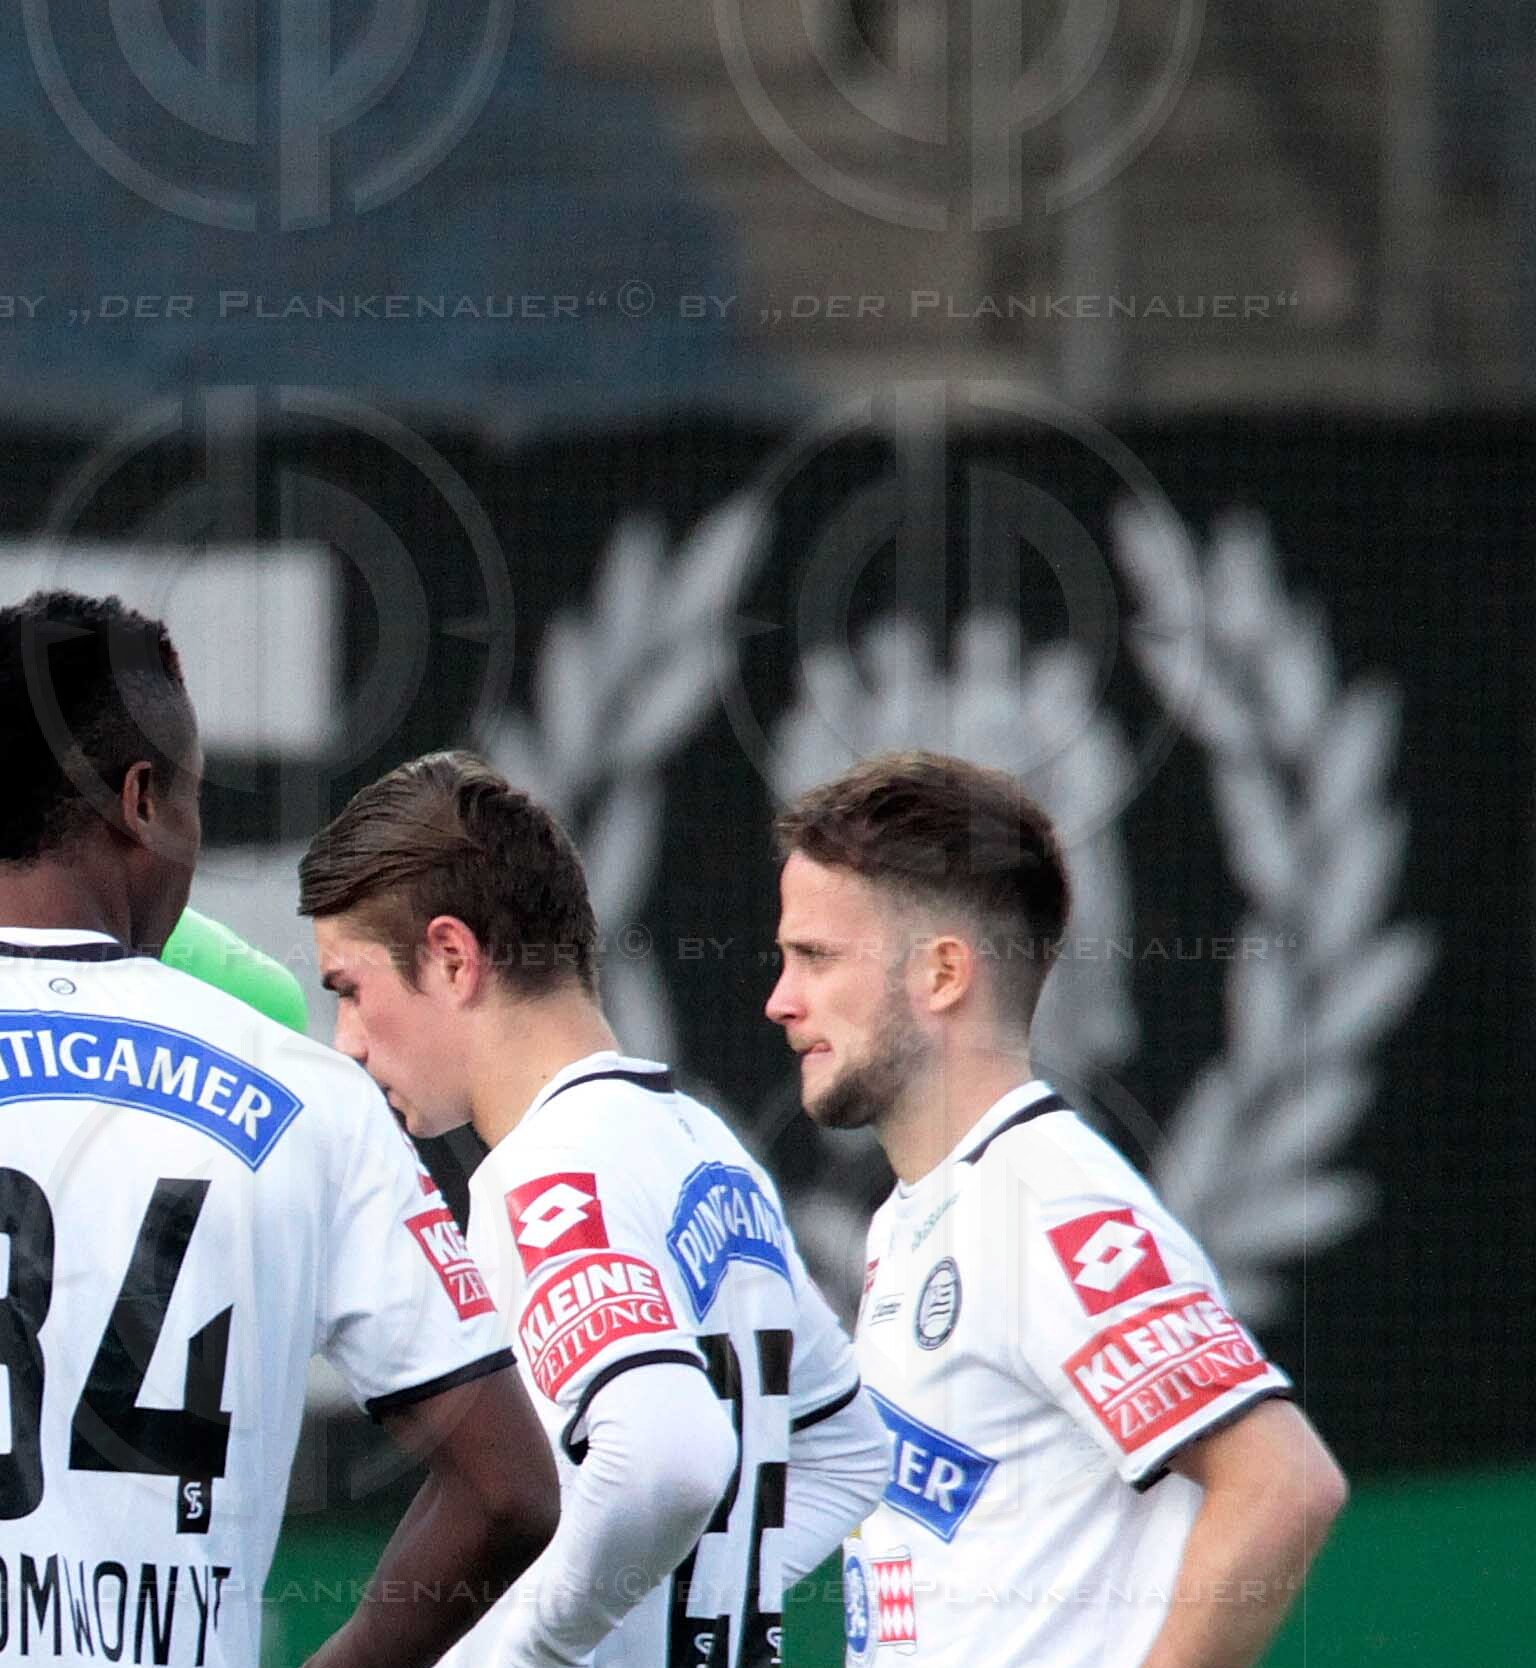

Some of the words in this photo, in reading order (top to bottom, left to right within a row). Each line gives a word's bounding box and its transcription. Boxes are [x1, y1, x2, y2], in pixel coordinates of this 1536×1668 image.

[521, 1261, 662, 1361] KLEINE
[536, 1300, 669, 1394] ZEITUNG
[1075, 1300, 1236, 1403] KLEINE
[1109, 1341, 1258, 1439] ZEITUNG
